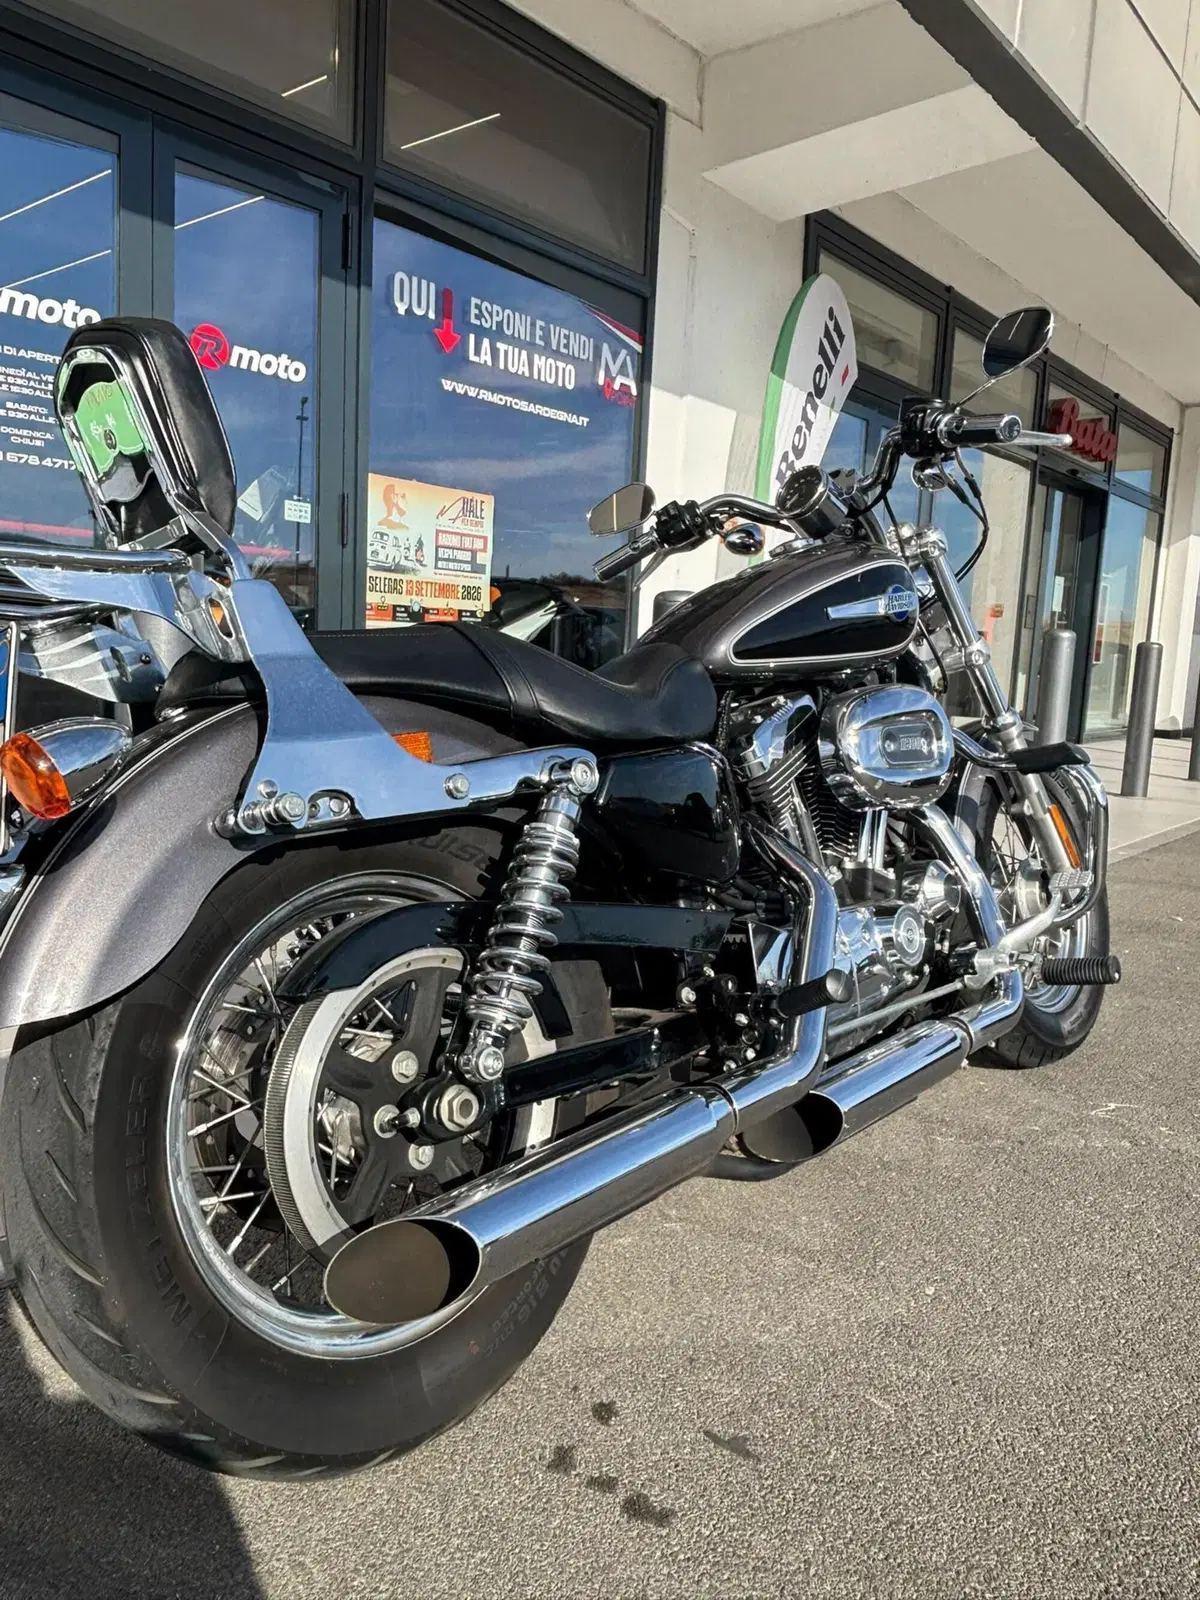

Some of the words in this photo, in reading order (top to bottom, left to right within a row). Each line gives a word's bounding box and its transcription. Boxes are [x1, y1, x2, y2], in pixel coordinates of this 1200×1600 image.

[0, 288, 101, 329] moto
[393, 271, 436, 320] QUI
[470, 297, 530, 342] ESPONI
[536, 319, 545, 346] E
[550, 323, 594, 363] VENDI
[229, 345, 306, 382] moto
[469, 333, 492, 367] LA
[496, 342, 529, 377] TUA
[533, 353, 576, 390] MOTO
[776, 306, 846, 485] Benelli
[6, 452, 40, 466] 678
[405, 580, 414, 596] 13
[415, 580, 460, 600] SETTEMBRE
